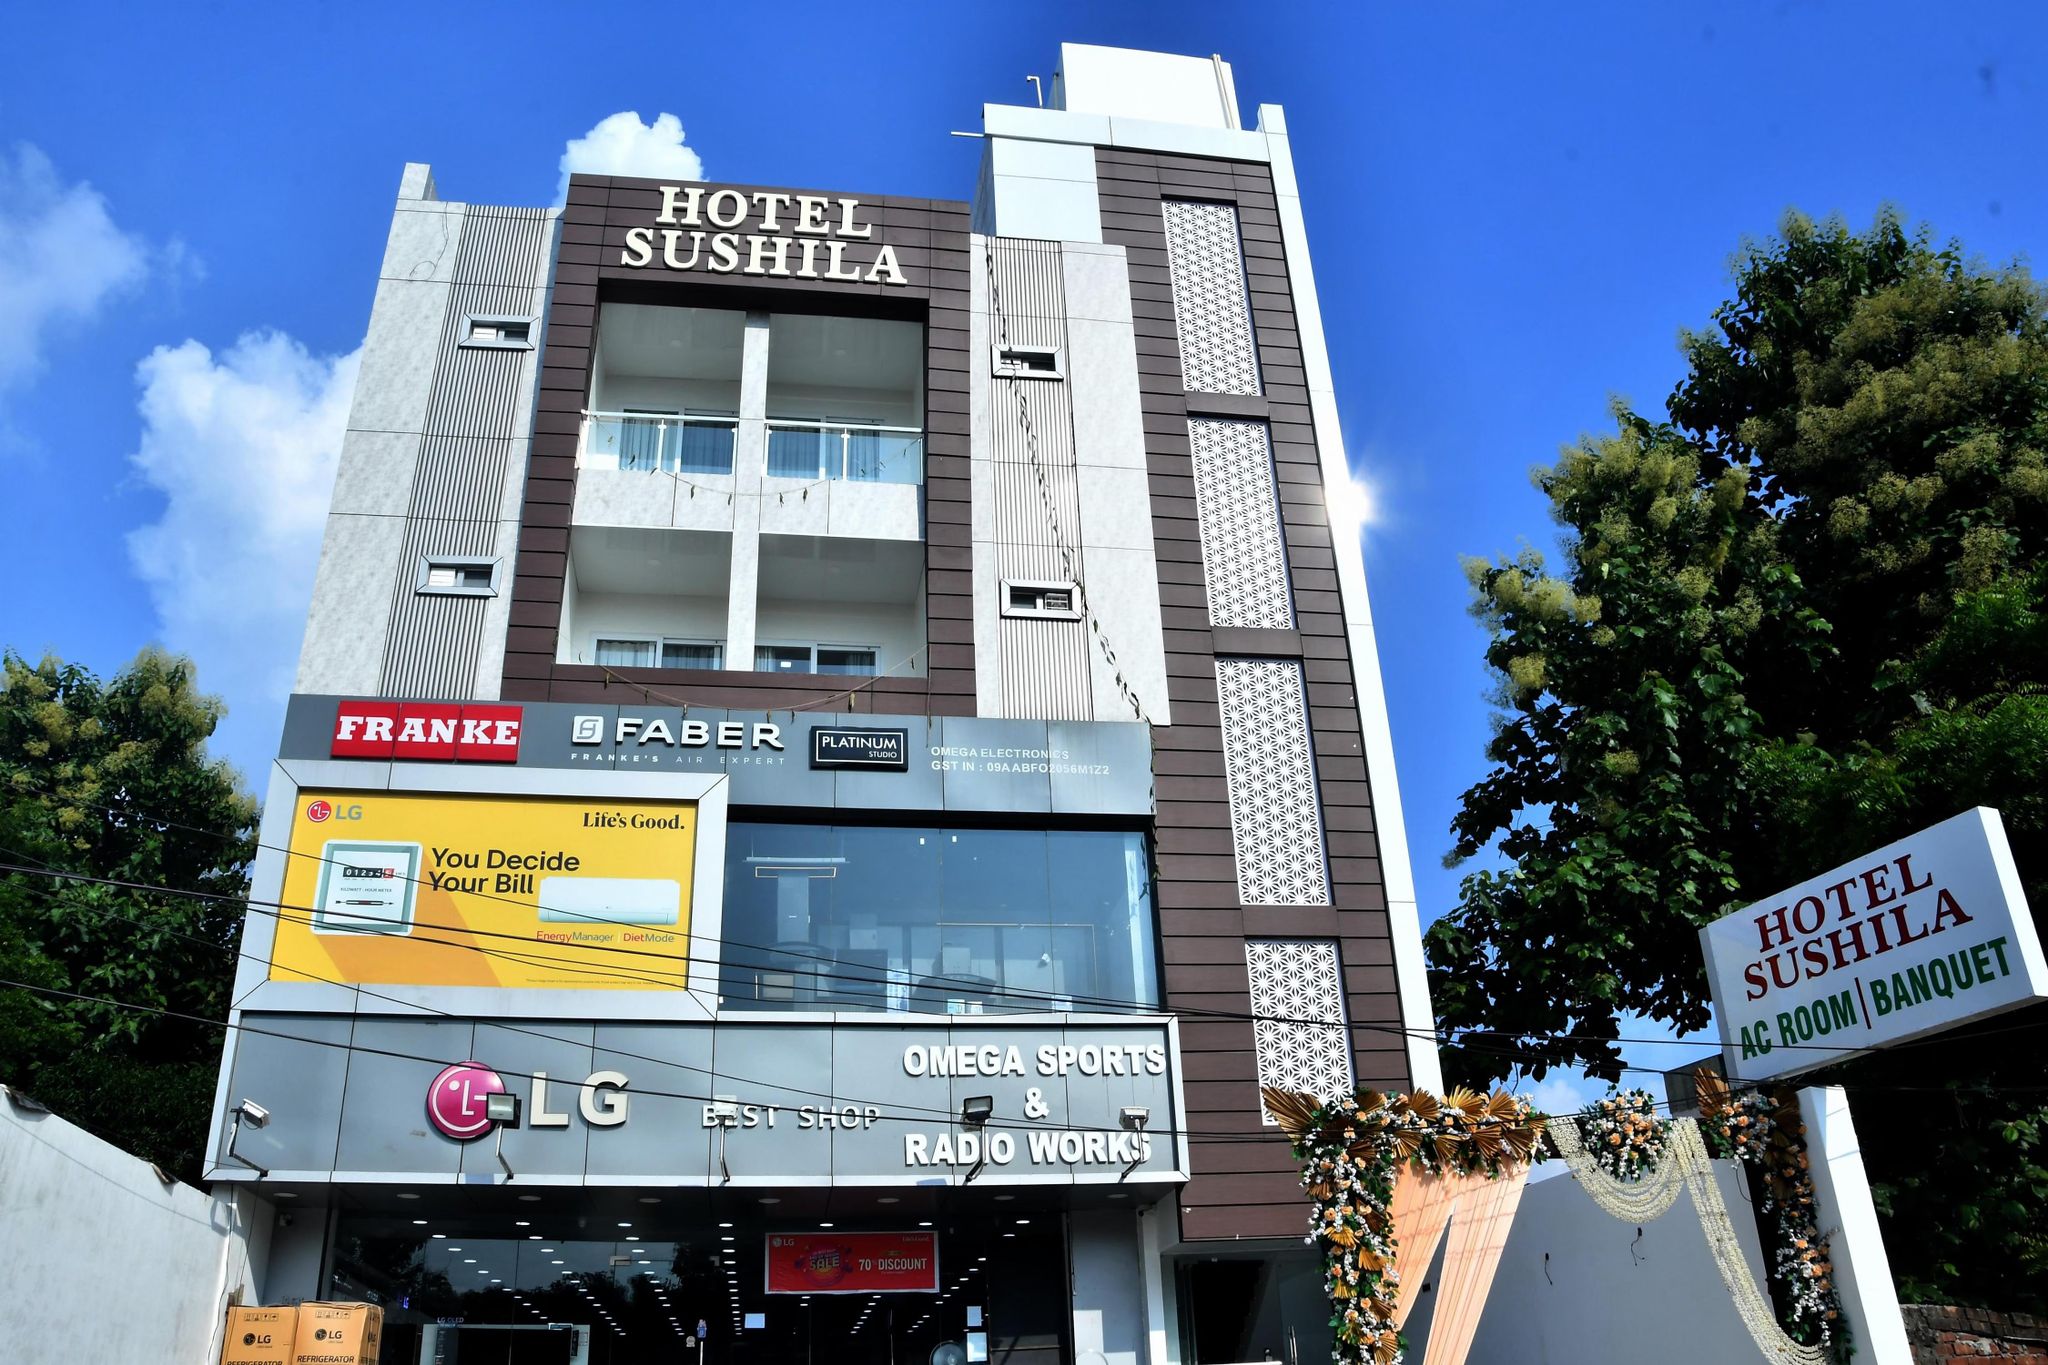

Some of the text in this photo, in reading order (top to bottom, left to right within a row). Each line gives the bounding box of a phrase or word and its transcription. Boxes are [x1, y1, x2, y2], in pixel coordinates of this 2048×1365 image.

[655, 186, 872, 239] HOTEL
[620, 228, 908, 285] SUSHILA
[336, 715, 519, 745] FRANKE
[616, 717, 785, 749] FABER
[822, 736, 897, 750] PLATINUM
[931, 747, 1070, 760] OMEGA ELECTRONICS
[571, 753, 659, 763] FRANKE'S
[720, 757, 785, 766] EXPERT
[868, 751, 898, 759] STUDIO
[931, 761, 959, 771] GST
[962, 762, 975, 771] IN
[336, 804, 363, 821] LG
[583, 811, 685, 830] Life's Good.
[432, 847, 580, 871] You Decide
[429, 871, 534, 894] Your Bill
[1753, 853, 1933, 952] HOTEL
[536, 930, 675, 943] EnergyManager DietMode
[1743, 888, 1974, 1001] SUSHILA
[1740, 936, 2010, 1061] AC ROOM BANQUET
[904, 1044, 1167, 1076] OMEGA SPORTS
[530, 1071, 629, 1126] LG
[1024, 1087, 1049, 1119] &
[798, 1105, 880, 1129] SHOP
[905, 1131, 1152, 1165] RADIO WORKS
[783, 1239, 795, 1247] LG
[878, 1258, 927, 1270] DISCOUNT
[257, 1334, 272, 1344] LG
[328, 1330, 343, 1340] LG
[297, 1354, 355, 1363] REFRIGERATOR
